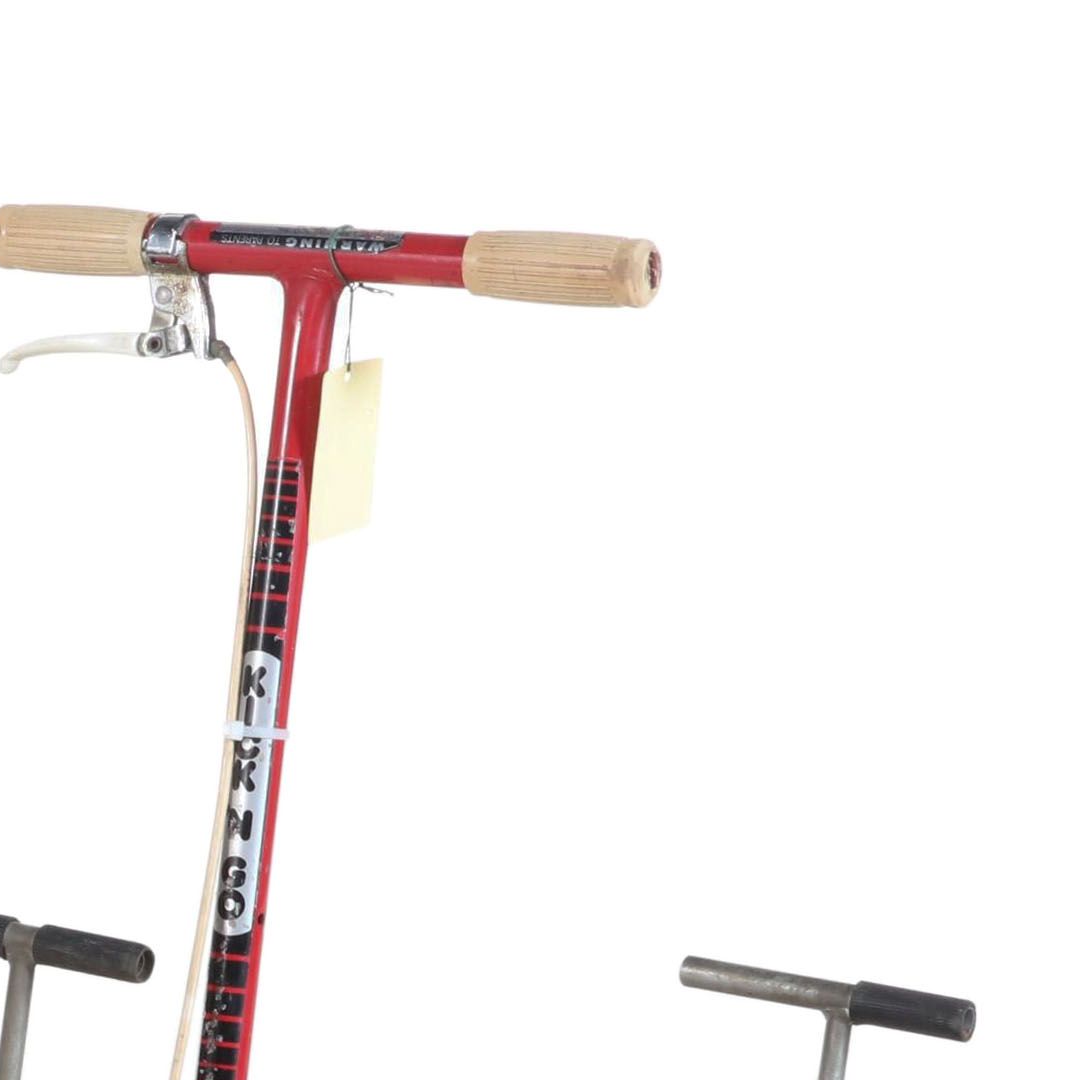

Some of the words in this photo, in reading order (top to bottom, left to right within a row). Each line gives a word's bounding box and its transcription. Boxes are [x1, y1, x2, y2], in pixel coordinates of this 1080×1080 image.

[221, 233, 263, 247] PARENTS
[267, 236, 282, 246] TO
[285, 238, 385, 253] WARNING
[232, 665, 267, 792] KICK
[218, 856, 247, 920] GO
